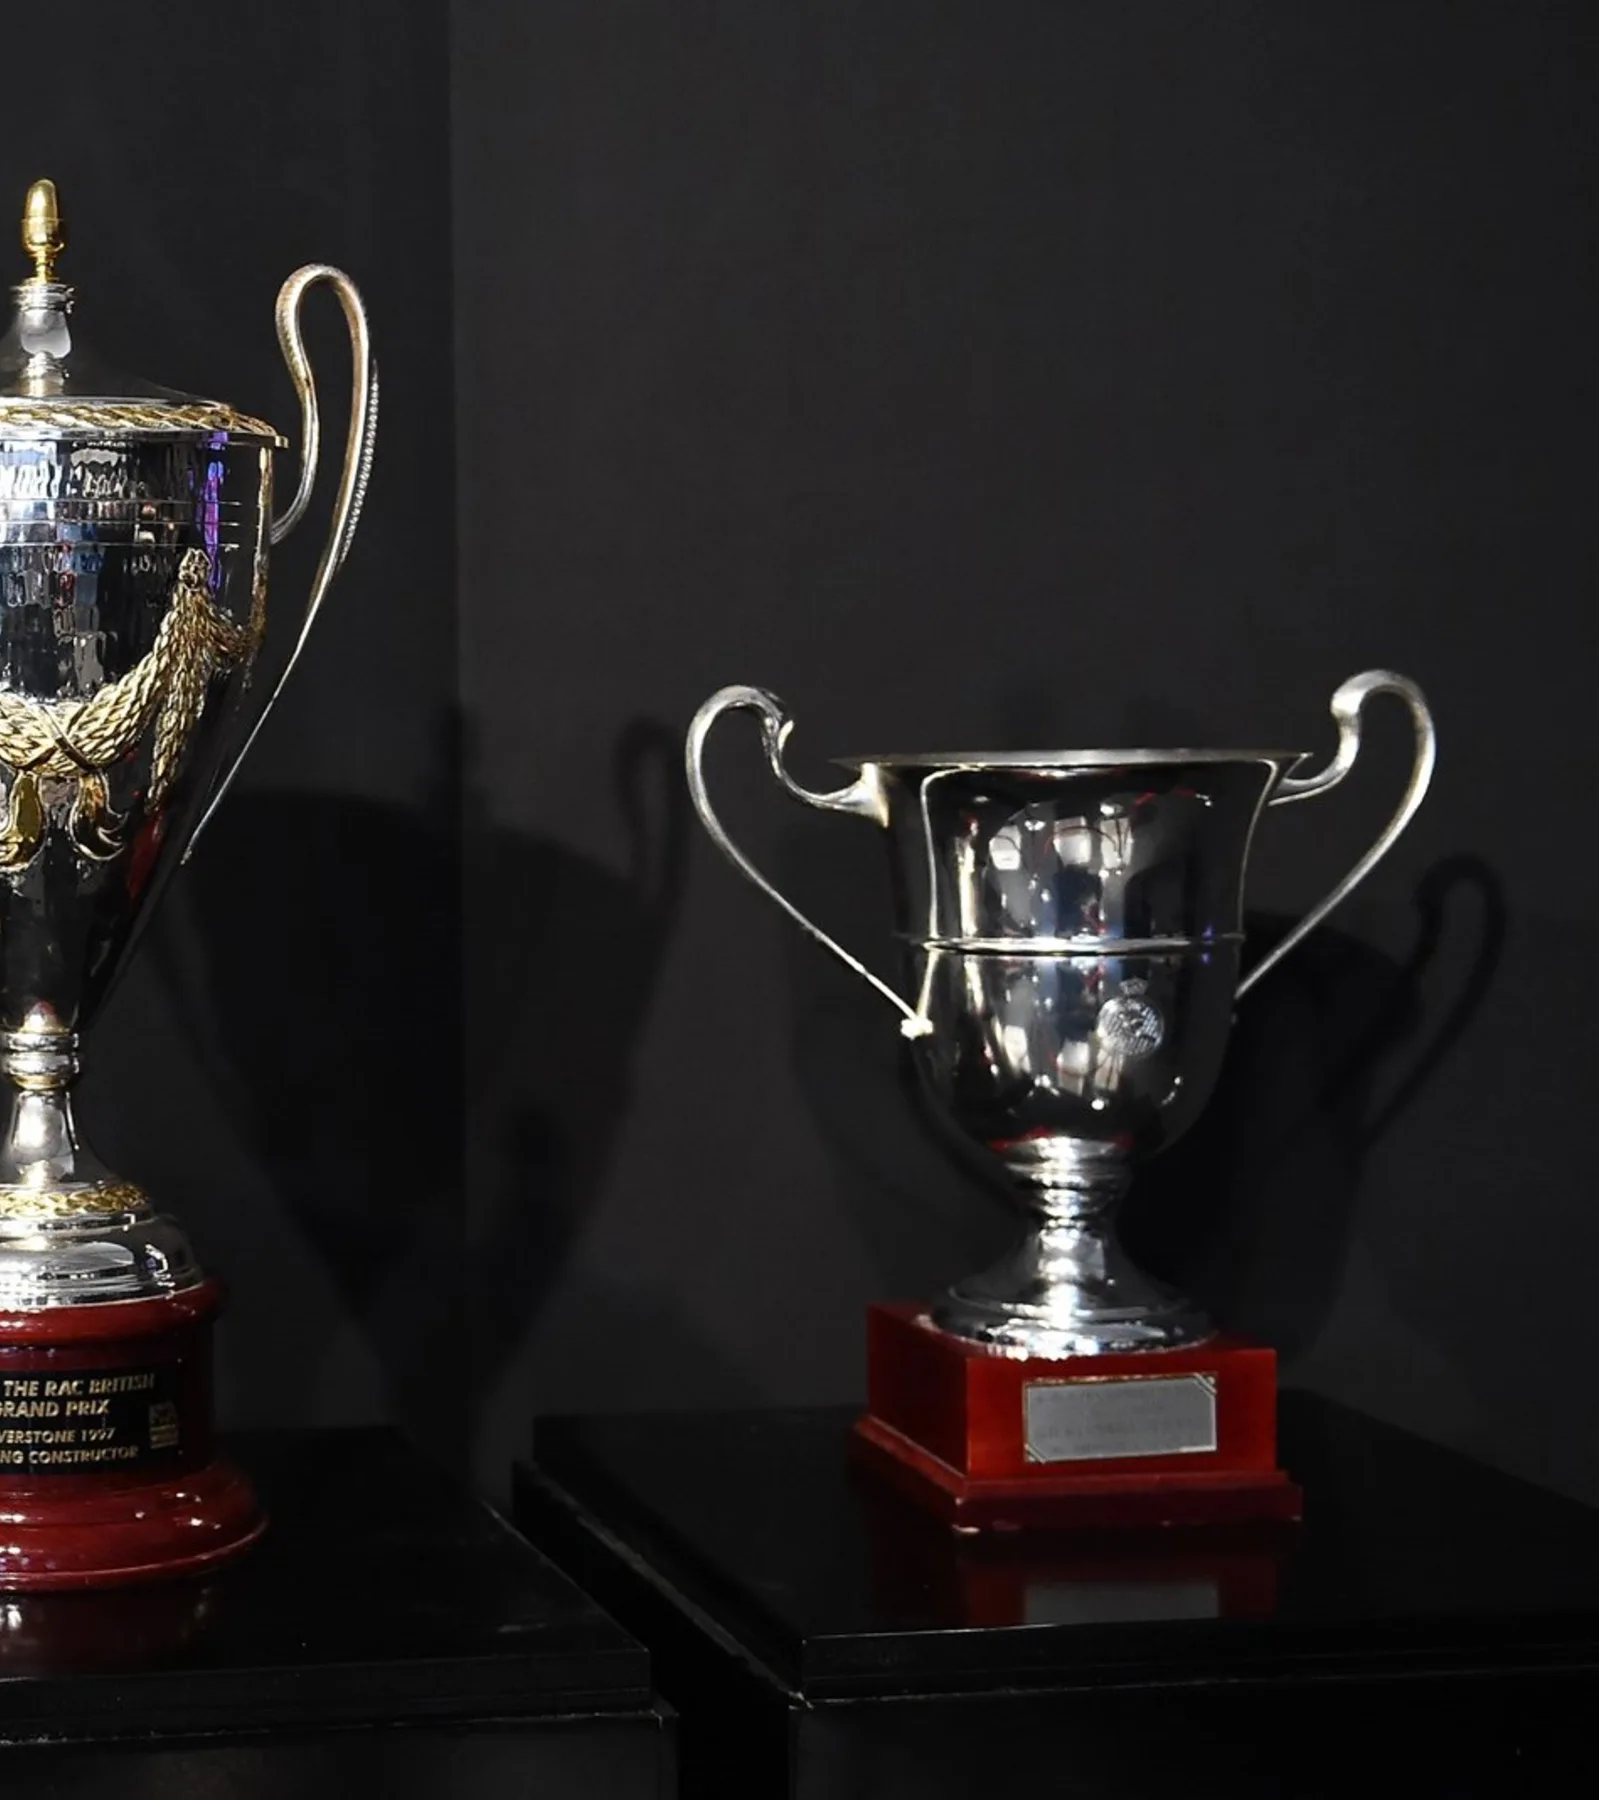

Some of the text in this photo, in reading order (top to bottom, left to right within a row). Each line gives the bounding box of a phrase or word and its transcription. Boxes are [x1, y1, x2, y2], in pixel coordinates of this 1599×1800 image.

[4, 1373, 155, 1398] THE RAC BRITISH
[66, 1399, 110, 1416] PRIX
[81, 1427, 116, 1442] 1997
[29, 1446, 138, 1464] CONSTRUCTOR
